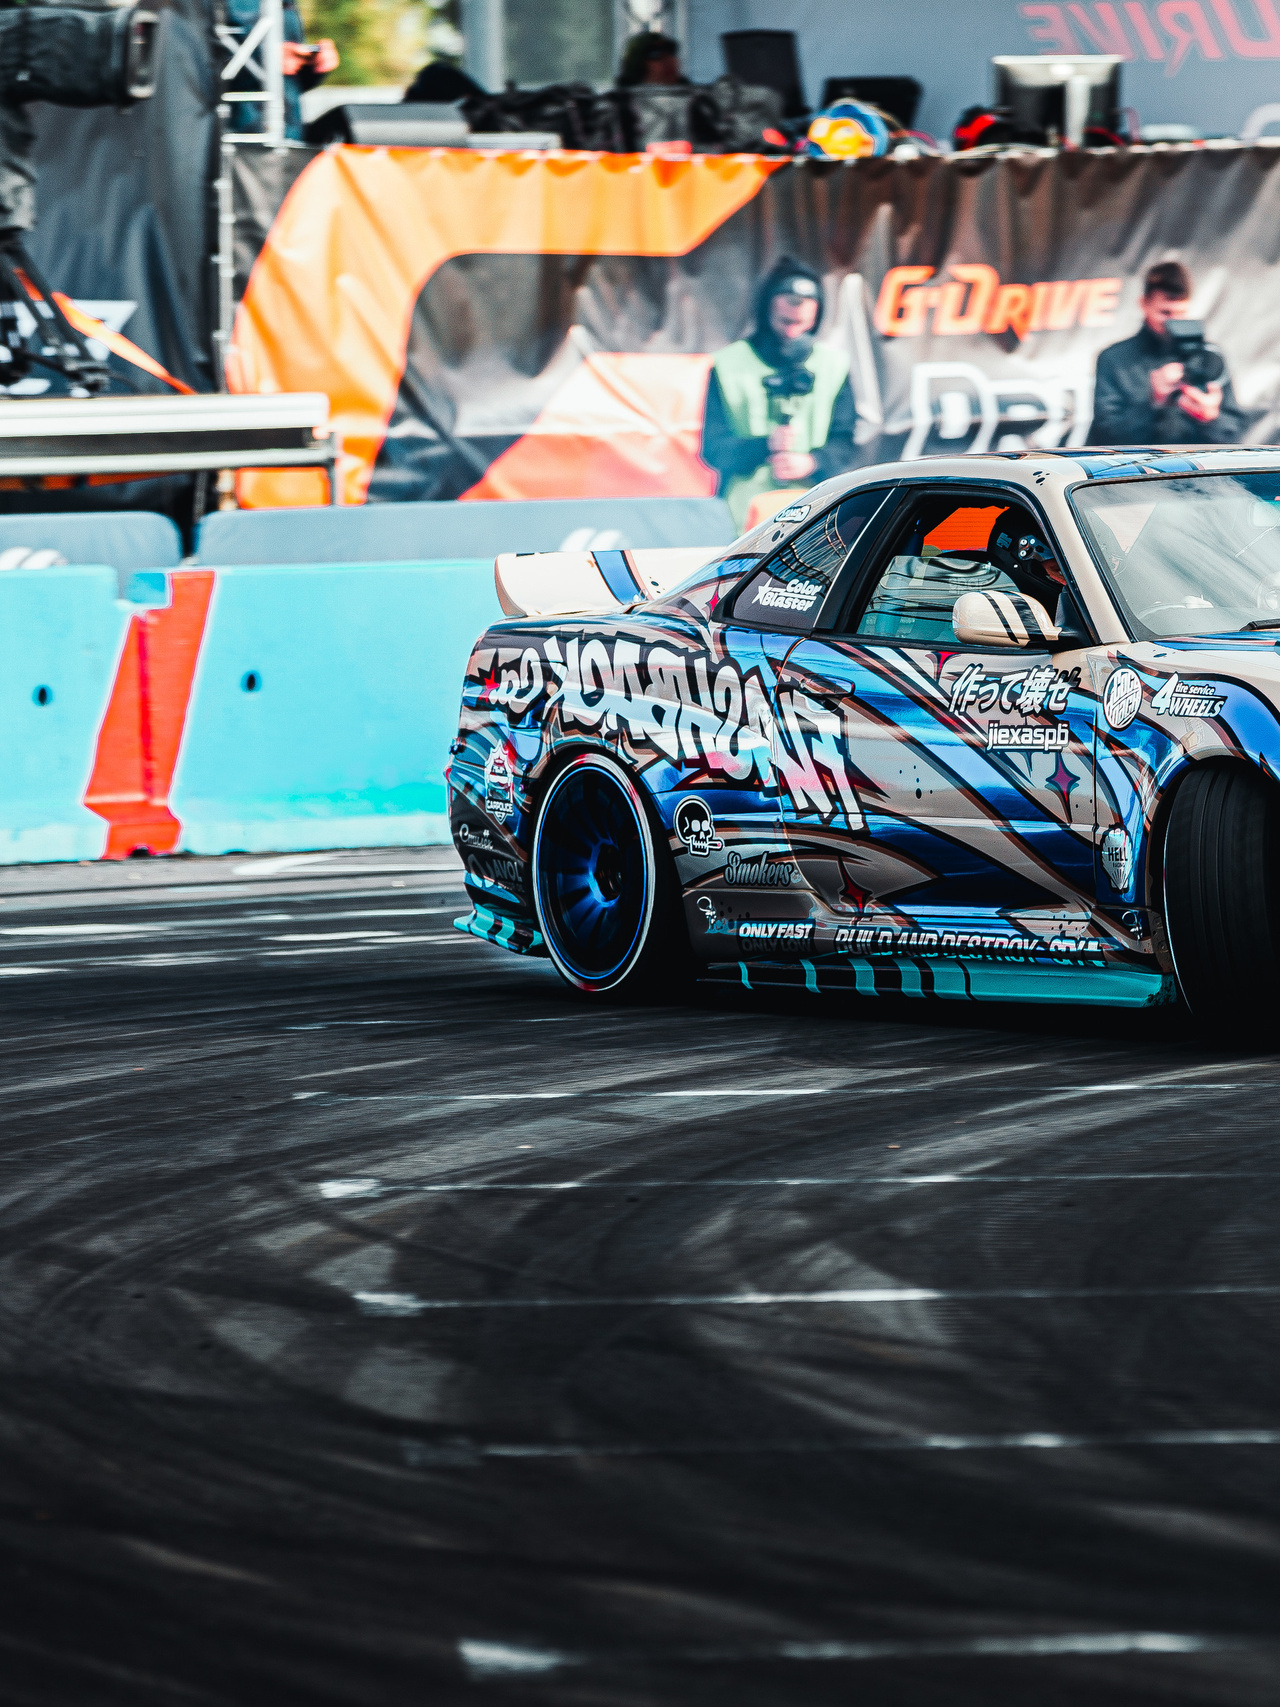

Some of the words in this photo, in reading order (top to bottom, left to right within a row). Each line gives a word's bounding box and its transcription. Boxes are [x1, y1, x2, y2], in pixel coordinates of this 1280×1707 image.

[786, 579, 822, 596] Color
[760, 592, 814, 611] Blaster
[1189, 685, 1214, 696] service
[1170, 698, 1225, 717] WHEELS
[1108, 847, 1128, 861] HELL
[725, 852, 792, 885] Smokers
[739, 923, 778, 938] ONLY
[777, 924, 813, 939] FAST
